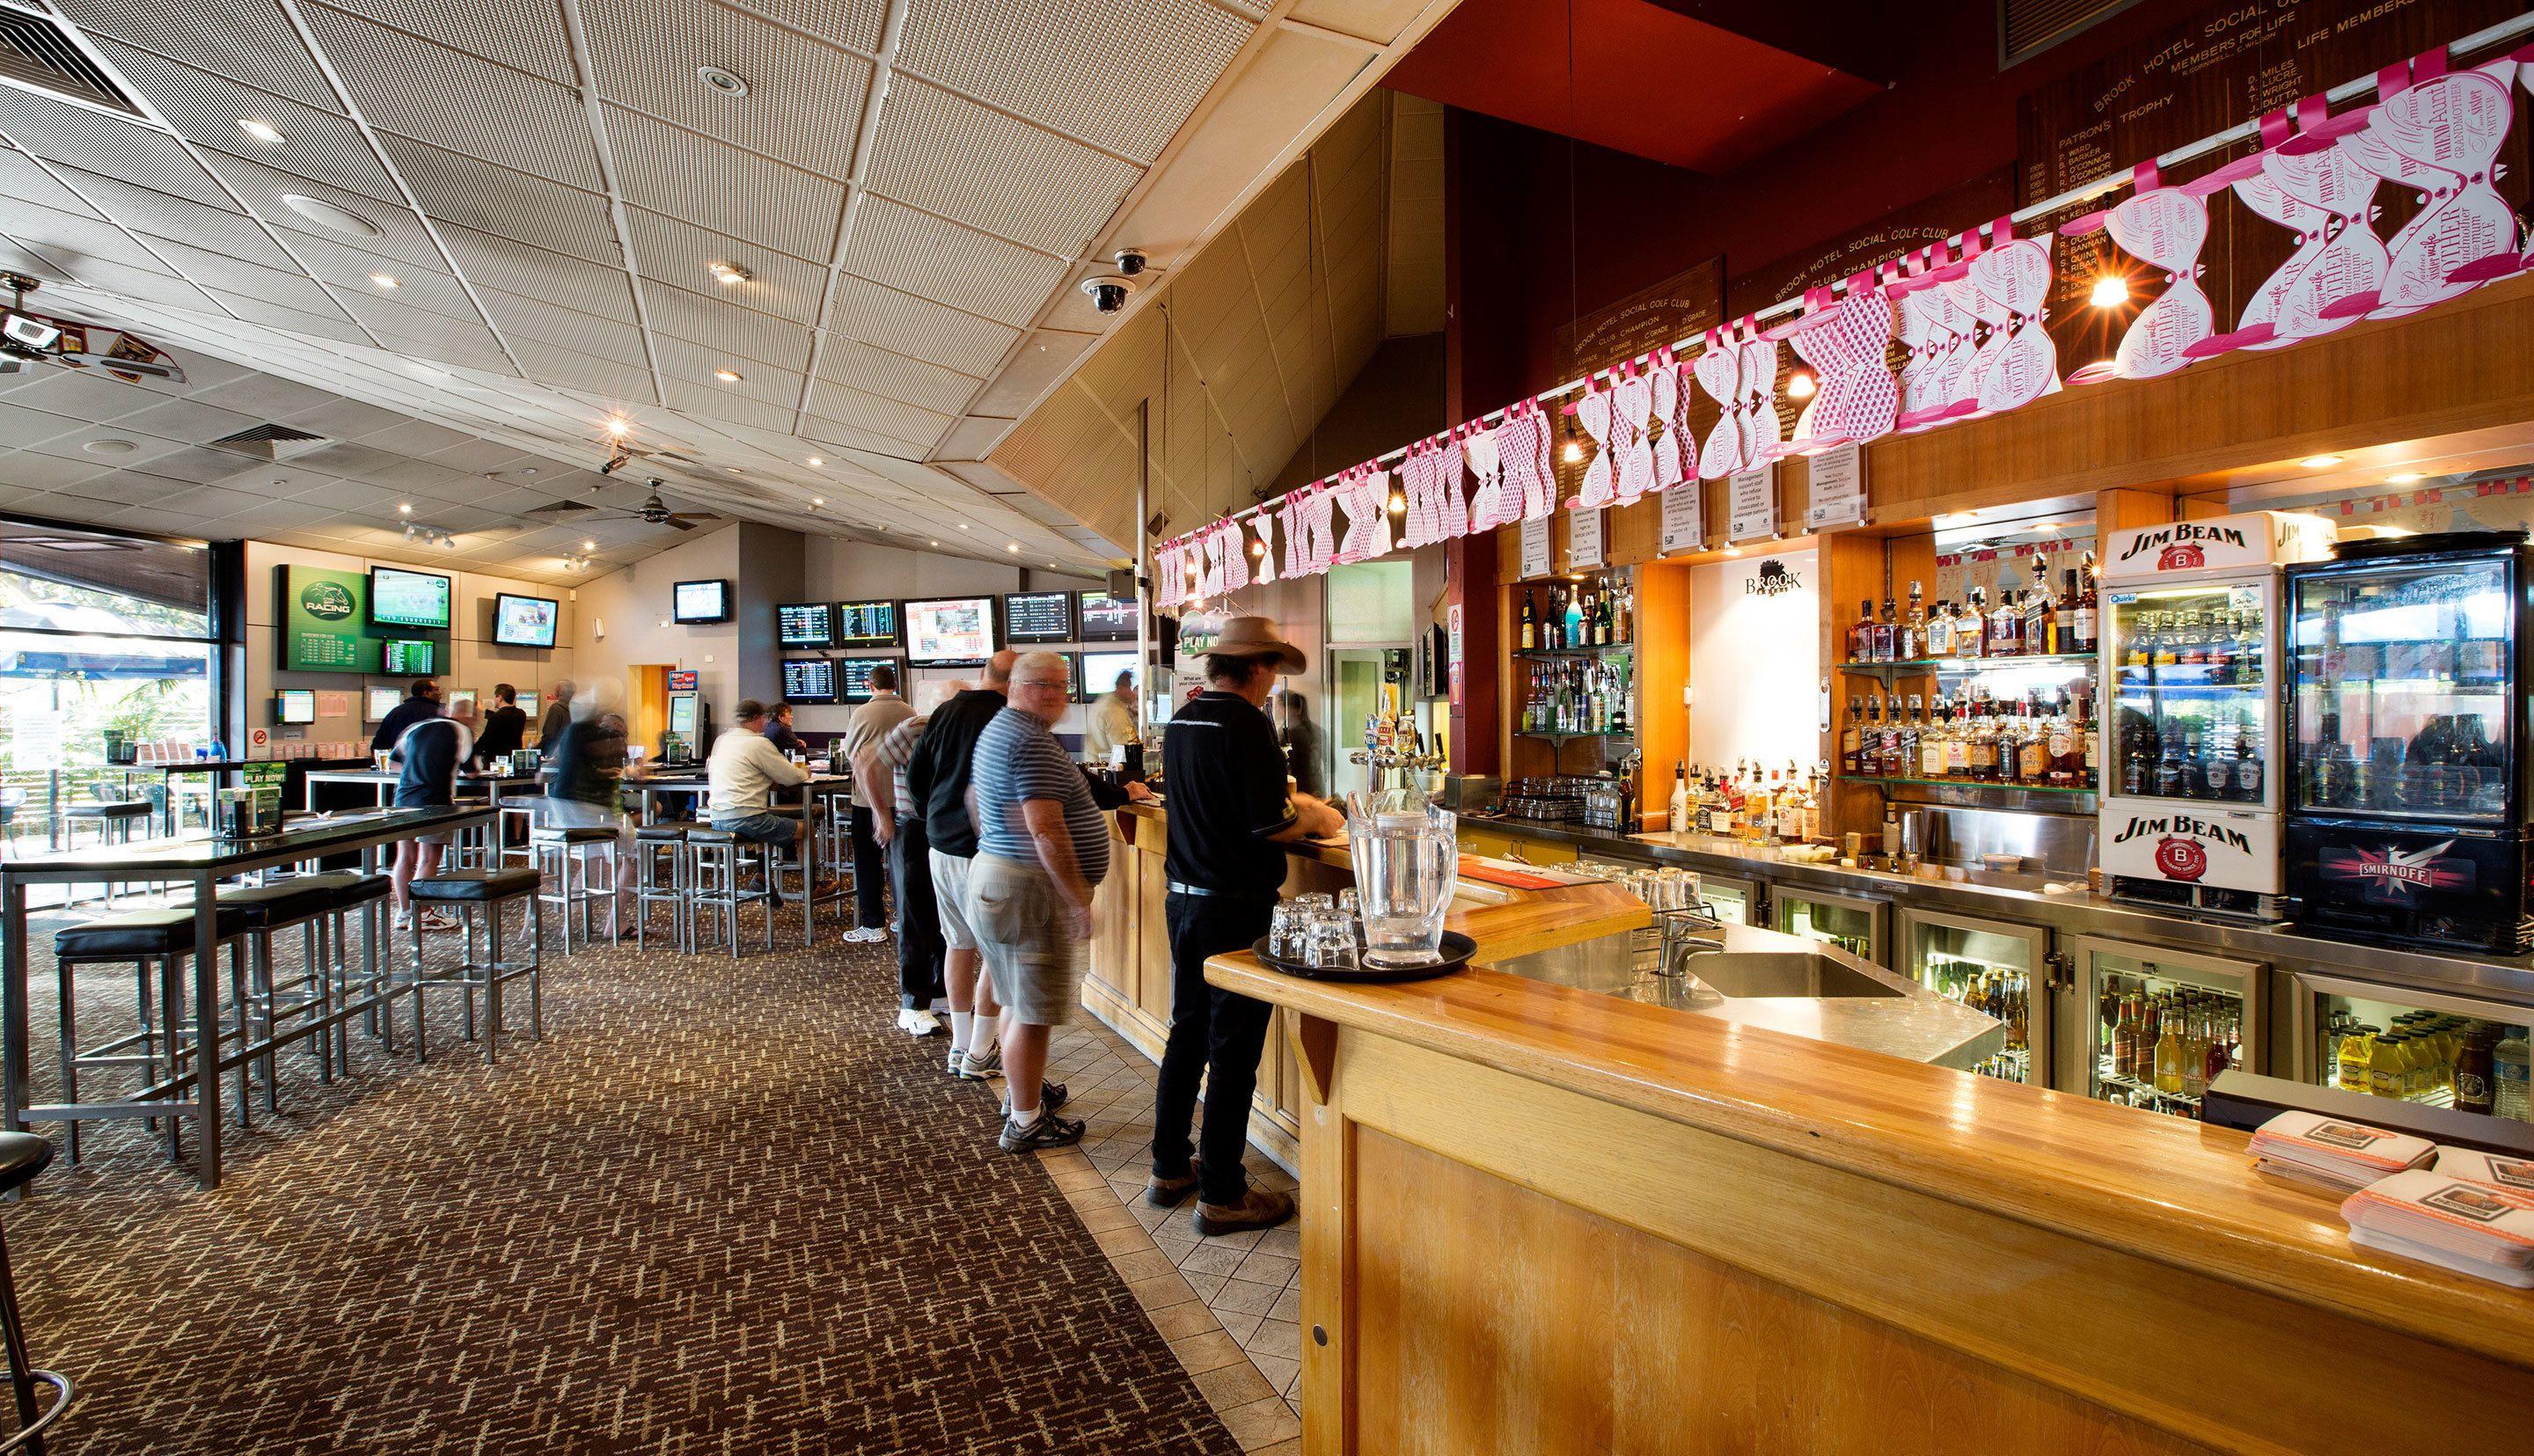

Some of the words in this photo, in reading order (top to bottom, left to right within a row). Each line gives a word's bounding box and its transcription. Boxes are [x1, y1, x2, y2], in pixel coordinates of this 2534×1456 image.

[2171, 39, 2235, 73] MEMBERS
[2240, 27, 2261, 44] FOR
[2267, 11, 2296, 31] LIFE
[2297, 27, 2330, 49] LIFE
[2093, 74, 2136, 113] BROOK
[2142, 38, 2195, 74] HOTEL
[2204, 4, 2268, 39] SOCIAL
[2262, 60, 2295, 77] MILES
[2262, 68, 2297, 87] LUCRE
[2262, 76, 2303, 97] WRIGHT
[2262, 90, 2298, 109] DUTTA
[2407, 91, 2419, 120] mum
[2426, 84, 2448, 124] Aunt
[2059, 121, 2112, 149] PATRON'S
[2120, 93, 2174, 123] TROPHY
[2450, 81, 2464, 159] GRANDMOTHER
[2486, 95, 2497, 137] PARTNER
[2069, 144, 2091, 157] WARD
[2433, 124, 2451, 162] FRIEND
[2068, 147, 2101, 165] BARKER
[2069, 153, 2111, 174] O'CONNOR
[2069, 162, 2111, 183] O'CONNOR
[2318, 170, 2334, 204] FRIEND
[2069, 203, 2097, 219] KELLY
[2164, 196, 2175, 259] GRANDMOTHER
[2189, 208, 2199, 242] PARTNER
[2070, 228, 2108, 245] O'CONNO
[2070, 237, 2107, 254] BANNAN
[2153, 230, 2165, 260] FRIEND
[2420, 233, 2442, 257] wife
[1774, 271, 1807, 303] BROOK
[1810, 250, 1843, 274] HOTEL
[1848, 233, 1886, 253] SOCIAL
[1891, 227, 1918, 242] GOLF
[1922, 227, 1950, 240] CLUB
[2070, 248, 2098, 264] QUINN
[2070, 258, 2098, 273] RIBAR
[1811, 274, 1838, 290] CLUB
[1843, 246, 1906, 276] CHAMPION
[2070, 267, 2098, 281] KELLY
[2006, 276, 2018, 304] FRIEND
[2397, 283, 2410, 299] sis
[1574, 333, 1596, 355] BROOK
[1597, 316, 1618, 333] HOTEL
[1620, 304, 1647, 319] SOCIAL
[1650, 298, 1669, 309] GOLF
[1671, 298, 1690, 309] CLUB
[1598, 333, 1616, 346] CLUB
[1620, 316, 1660, 338] CHAMPION
[2158, 297, 2175, 365] MOTHER
[2011, 339, 2025, 399] MOTHER
[1738, 472, 1764, 482] Management
[2120, 529, 2171, 561] JIM
[2174, 523, 2247, 549] BEAM
[2174, 553, 2187, 567] B
[1746, 572, 1802, 595] BROOK
[305, 602, 350, 613] RACING
[2111, 595, 2136, 604] Quirks
[1183, 636, 1205, 648] PLAY
[1206, 635, 1219, 648] NO
[245, 774, 265, 784] PLAY
[265, 773, 285, 783] NOW!
[2113, 816, 2169, 844] JIM
[2172, 816, 2253, 856] BEAM
[2174, 849, 2187, 862] B
[2363, 864, 2427, 883] SMIRNOFF
